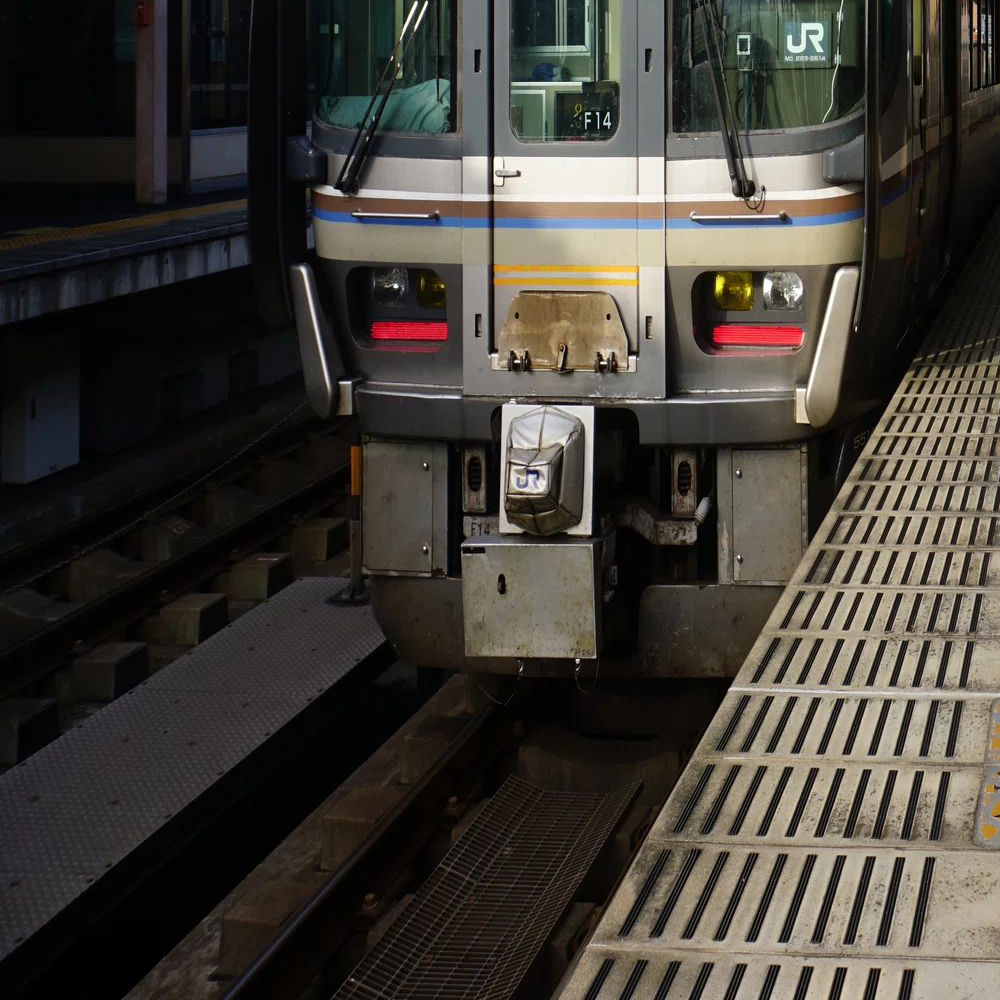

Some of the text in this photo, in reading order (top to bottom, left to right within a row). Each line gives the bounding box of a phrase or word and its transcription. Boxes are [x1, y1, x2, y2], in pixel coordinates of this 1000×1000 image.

[786, 22, 824, 54] JR
[584, 111, 612, 130] F14
[516, 469, 540, 490] JR
[471, 522, 490, 537] F14
